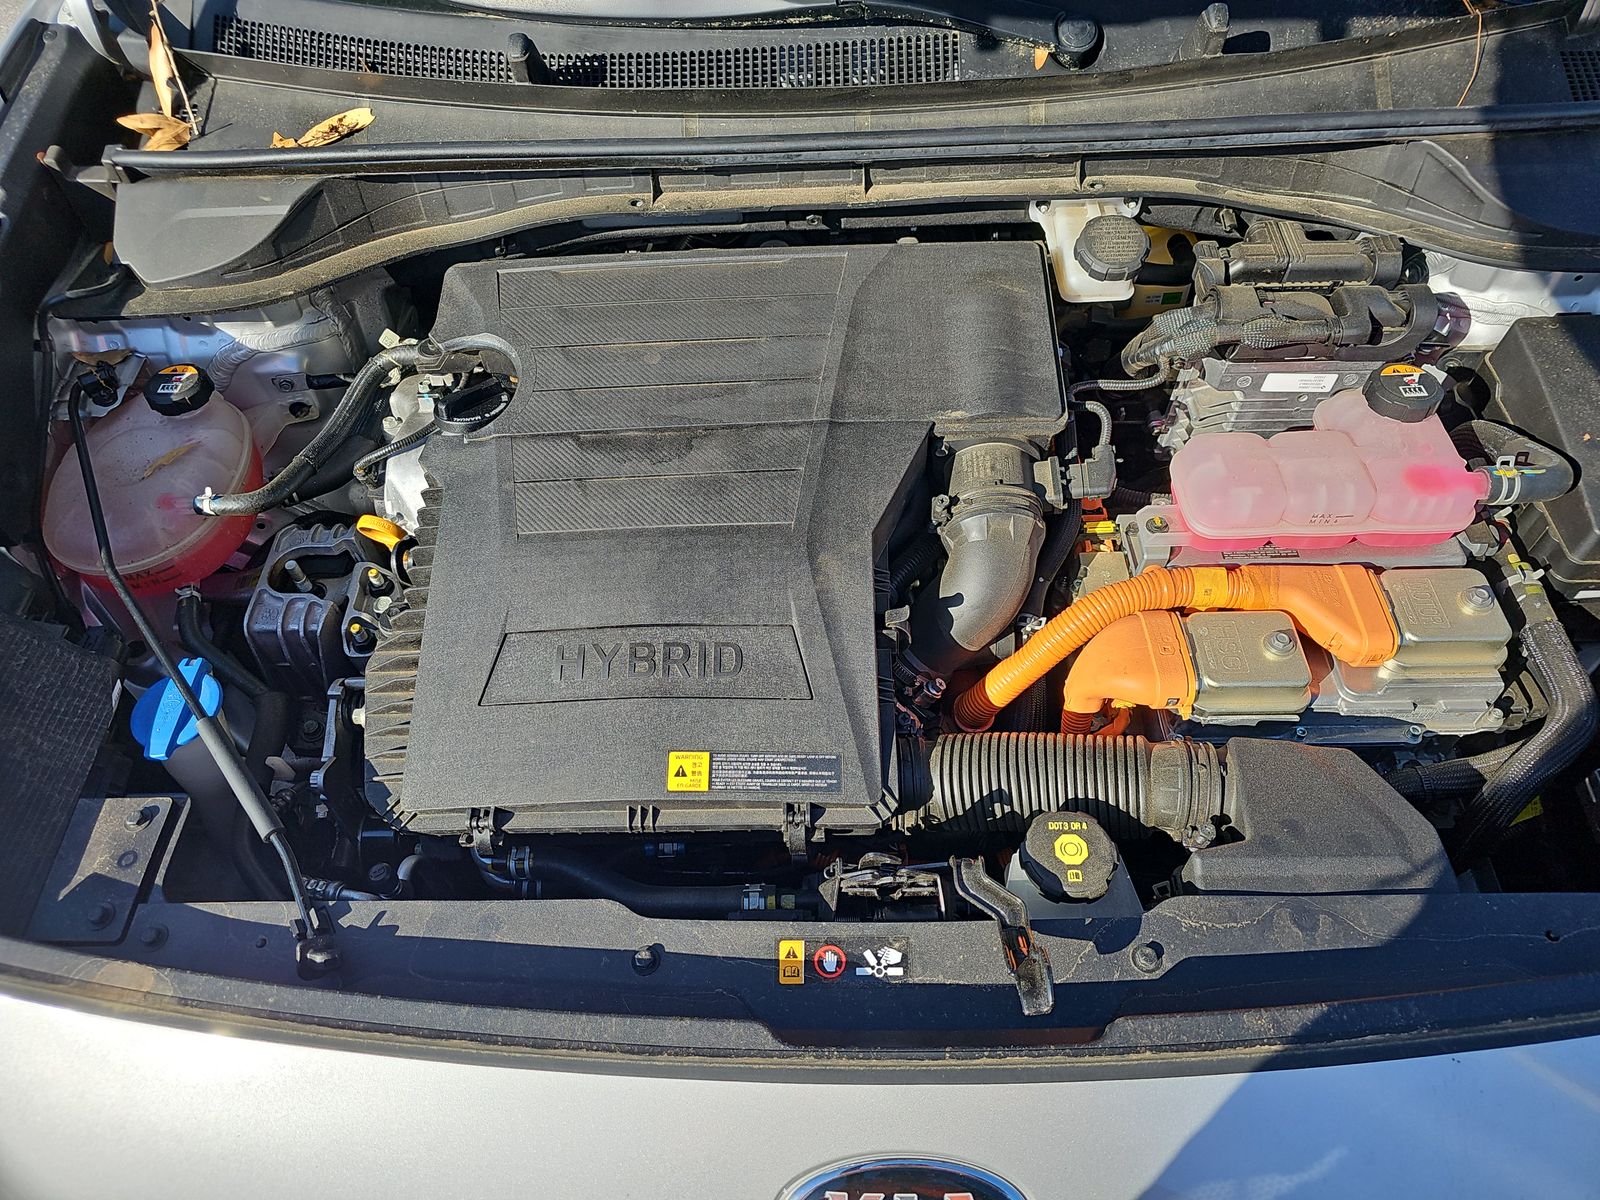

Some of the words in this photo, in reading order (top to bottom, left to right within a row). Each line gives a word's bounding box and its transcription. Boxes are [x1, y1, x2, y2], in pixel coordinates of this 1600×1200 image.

[556, 642, 744, 681] HYBRID
[1071, 822, 1081, 830] OR
[1082, 822, 1088, 830] 4
